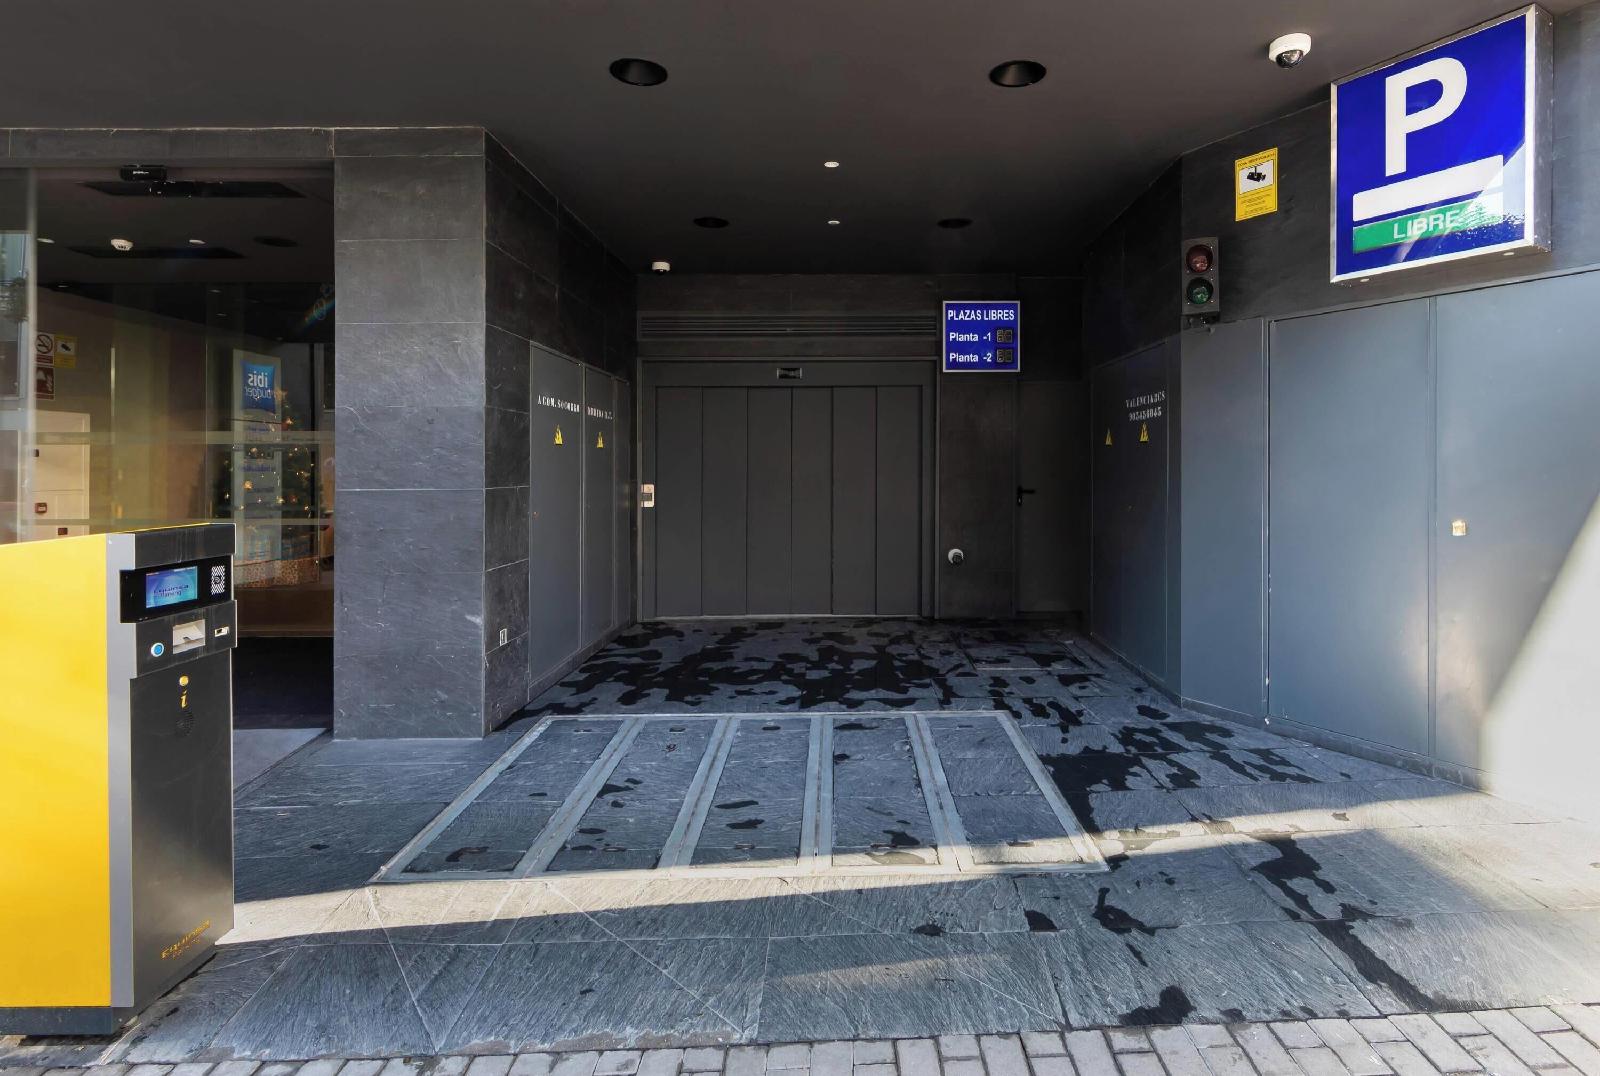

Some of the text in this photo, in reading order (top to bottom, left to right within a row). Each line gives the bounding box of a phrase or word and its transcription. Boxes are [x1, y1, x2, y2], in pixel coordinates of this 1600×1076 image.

[1385, 57, 1468, 177] P
[1393, 209, 1462, 239] LIBRE
[947, 309, 1015, 321] PLAZAS LIBRES
[949, 331, 991, 342] Planta -1
[949, 352, 993, 363] Planta -2
